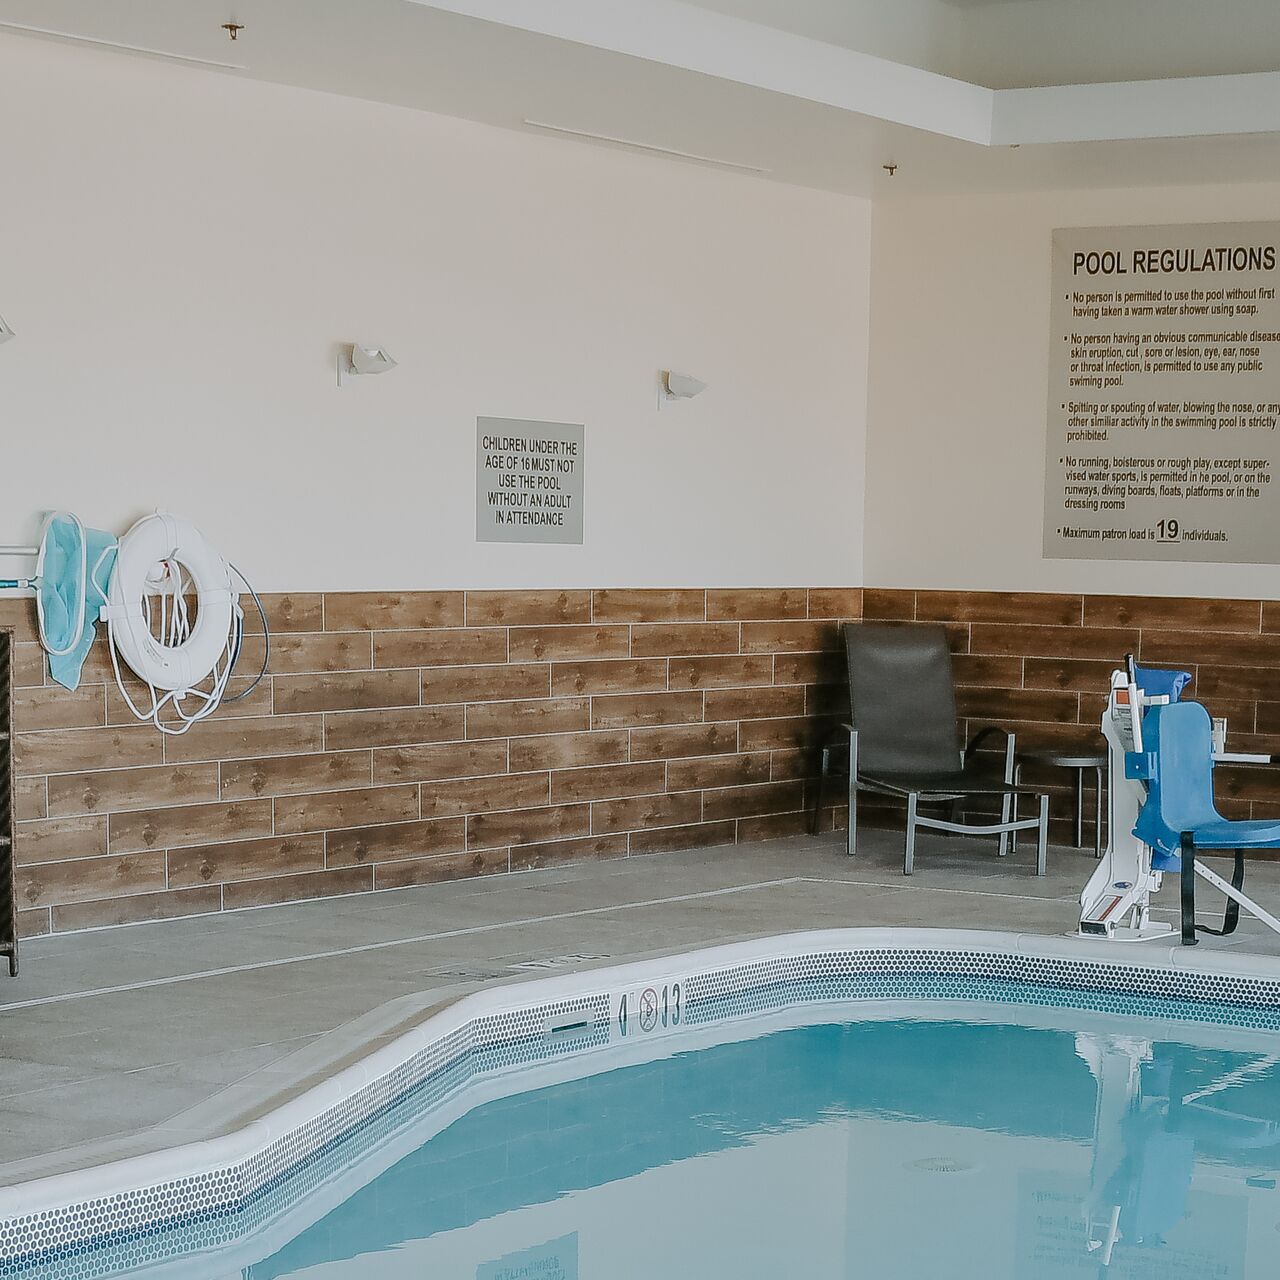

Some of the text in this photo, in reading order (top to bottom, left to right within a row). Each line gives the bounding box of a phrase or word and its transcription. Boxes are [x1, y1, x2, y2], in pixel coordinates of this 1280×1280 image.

[1074, 246, 1275, 275] POOL REGULATIONS
[1073, 287, 1275, 305] No person is permitted to use the pool without first
[1073, 303, 1259, 318] having taken a warm water shower using soap.
[1071, 333, 1082, 344] No
[1084, 335, 1111, 346] person
[1113, 332, 1140, 346] having
[1142, 334, 1152, 343] an
[1154, 331, 1186, 343] obvious
[1188, 330, 1248, 343] communicable
[1071, 345, 1087, 358] skin
[1089, 346, 1124, 360] eruption,
[1145, 349, 1163, 358] sore
[1165, 348, 1174, 357] or
[1175, 345, 1202, 359] lesion,
[1204, 347, 1220, 359] eye,
[1222, 348, 1237, 359] ear,
[1239, 347, 1260, 356] nose
[1070, 363, 1079, 372] or
[1081, 360, 1104, 372] throat
[1144, 360, 1151, 372] is
[1153, 360, 1192, 374] permitted
[1193, 361, 1202, 371] to
[1203, 362, 1218, 371] use
[1220, 362, 1236, 374] any
[1237, 359, 1263, 374] public
[1104, 375, 1124, 388] pool.
[1068, 401, 1098, 415] Spitting
[1100, 404, 1109, 413] or
[1111, 401, 1146, 415] spouting
[1147, 401, 1156, 413] of
[1157, 402, 1181, 414] water,
[1183, 401, 1215, 415] blowing
[1217, 401, 1230, 413] the
[1232, 404, 1255, 414] nose,
[1255, 404, 1266, 414] or
[1068, 415, 1089, 427] other
[1121, 415, 1150, 430] activity
[1151, 415, 1159, 427] in
[1161, 415, 1173, 427] the
[1175, 415, 1217, 430] swimming
[1218, 416, 1237, 430] pool
[1239, 416, 1246, 427] is
[1249, 416, 1277, 430] strictly
[1067, 429, 1109, 443] prohibited.
[483, 436, 577, 455] CHILDREN UNDER THE
[485, 455, 574, 473] AGE OF 16 MUST NOT
[1066, 456, 1077, 467] No
[1078, 456, 1111, 470] running,
[1113, 456, 1155, 468] boisterous
[1157, 459, 1166, 468] or
[1167, 457, 1191, 470] rough
[1193, 457, 1212, 471] play,
[1214, 458, 1241, 471] except
[499, 474, 561, 490] USE THE POOL
[1088, 469, 1110, 481] water
[1111, 471, 1139, 484] sports,
[1141, 470, 1147, 481] is
[1149, 471, 1188, 484] permitted
[1189, 470, 1197, 482] in
[1199, 471, 1210, 482] he
[1211, 471, 1232, 485] pool,
[1234, 474, 1243, 485] or
[1244, 474, 1255, 483] on
[1257, 472, 1270, 483] the
[1065, 484, 1259, 499] runways, diving boards, floats, platforms or in the
[488, 491, 571, 508] WITHOUT AN ADULT
[1065, 497, 1098, 512] dressing
[496, 510, 563, 526] IN ATTENDANCE
[1063, 519, 1228, 542] Maximum patron load is 19 individuals.
